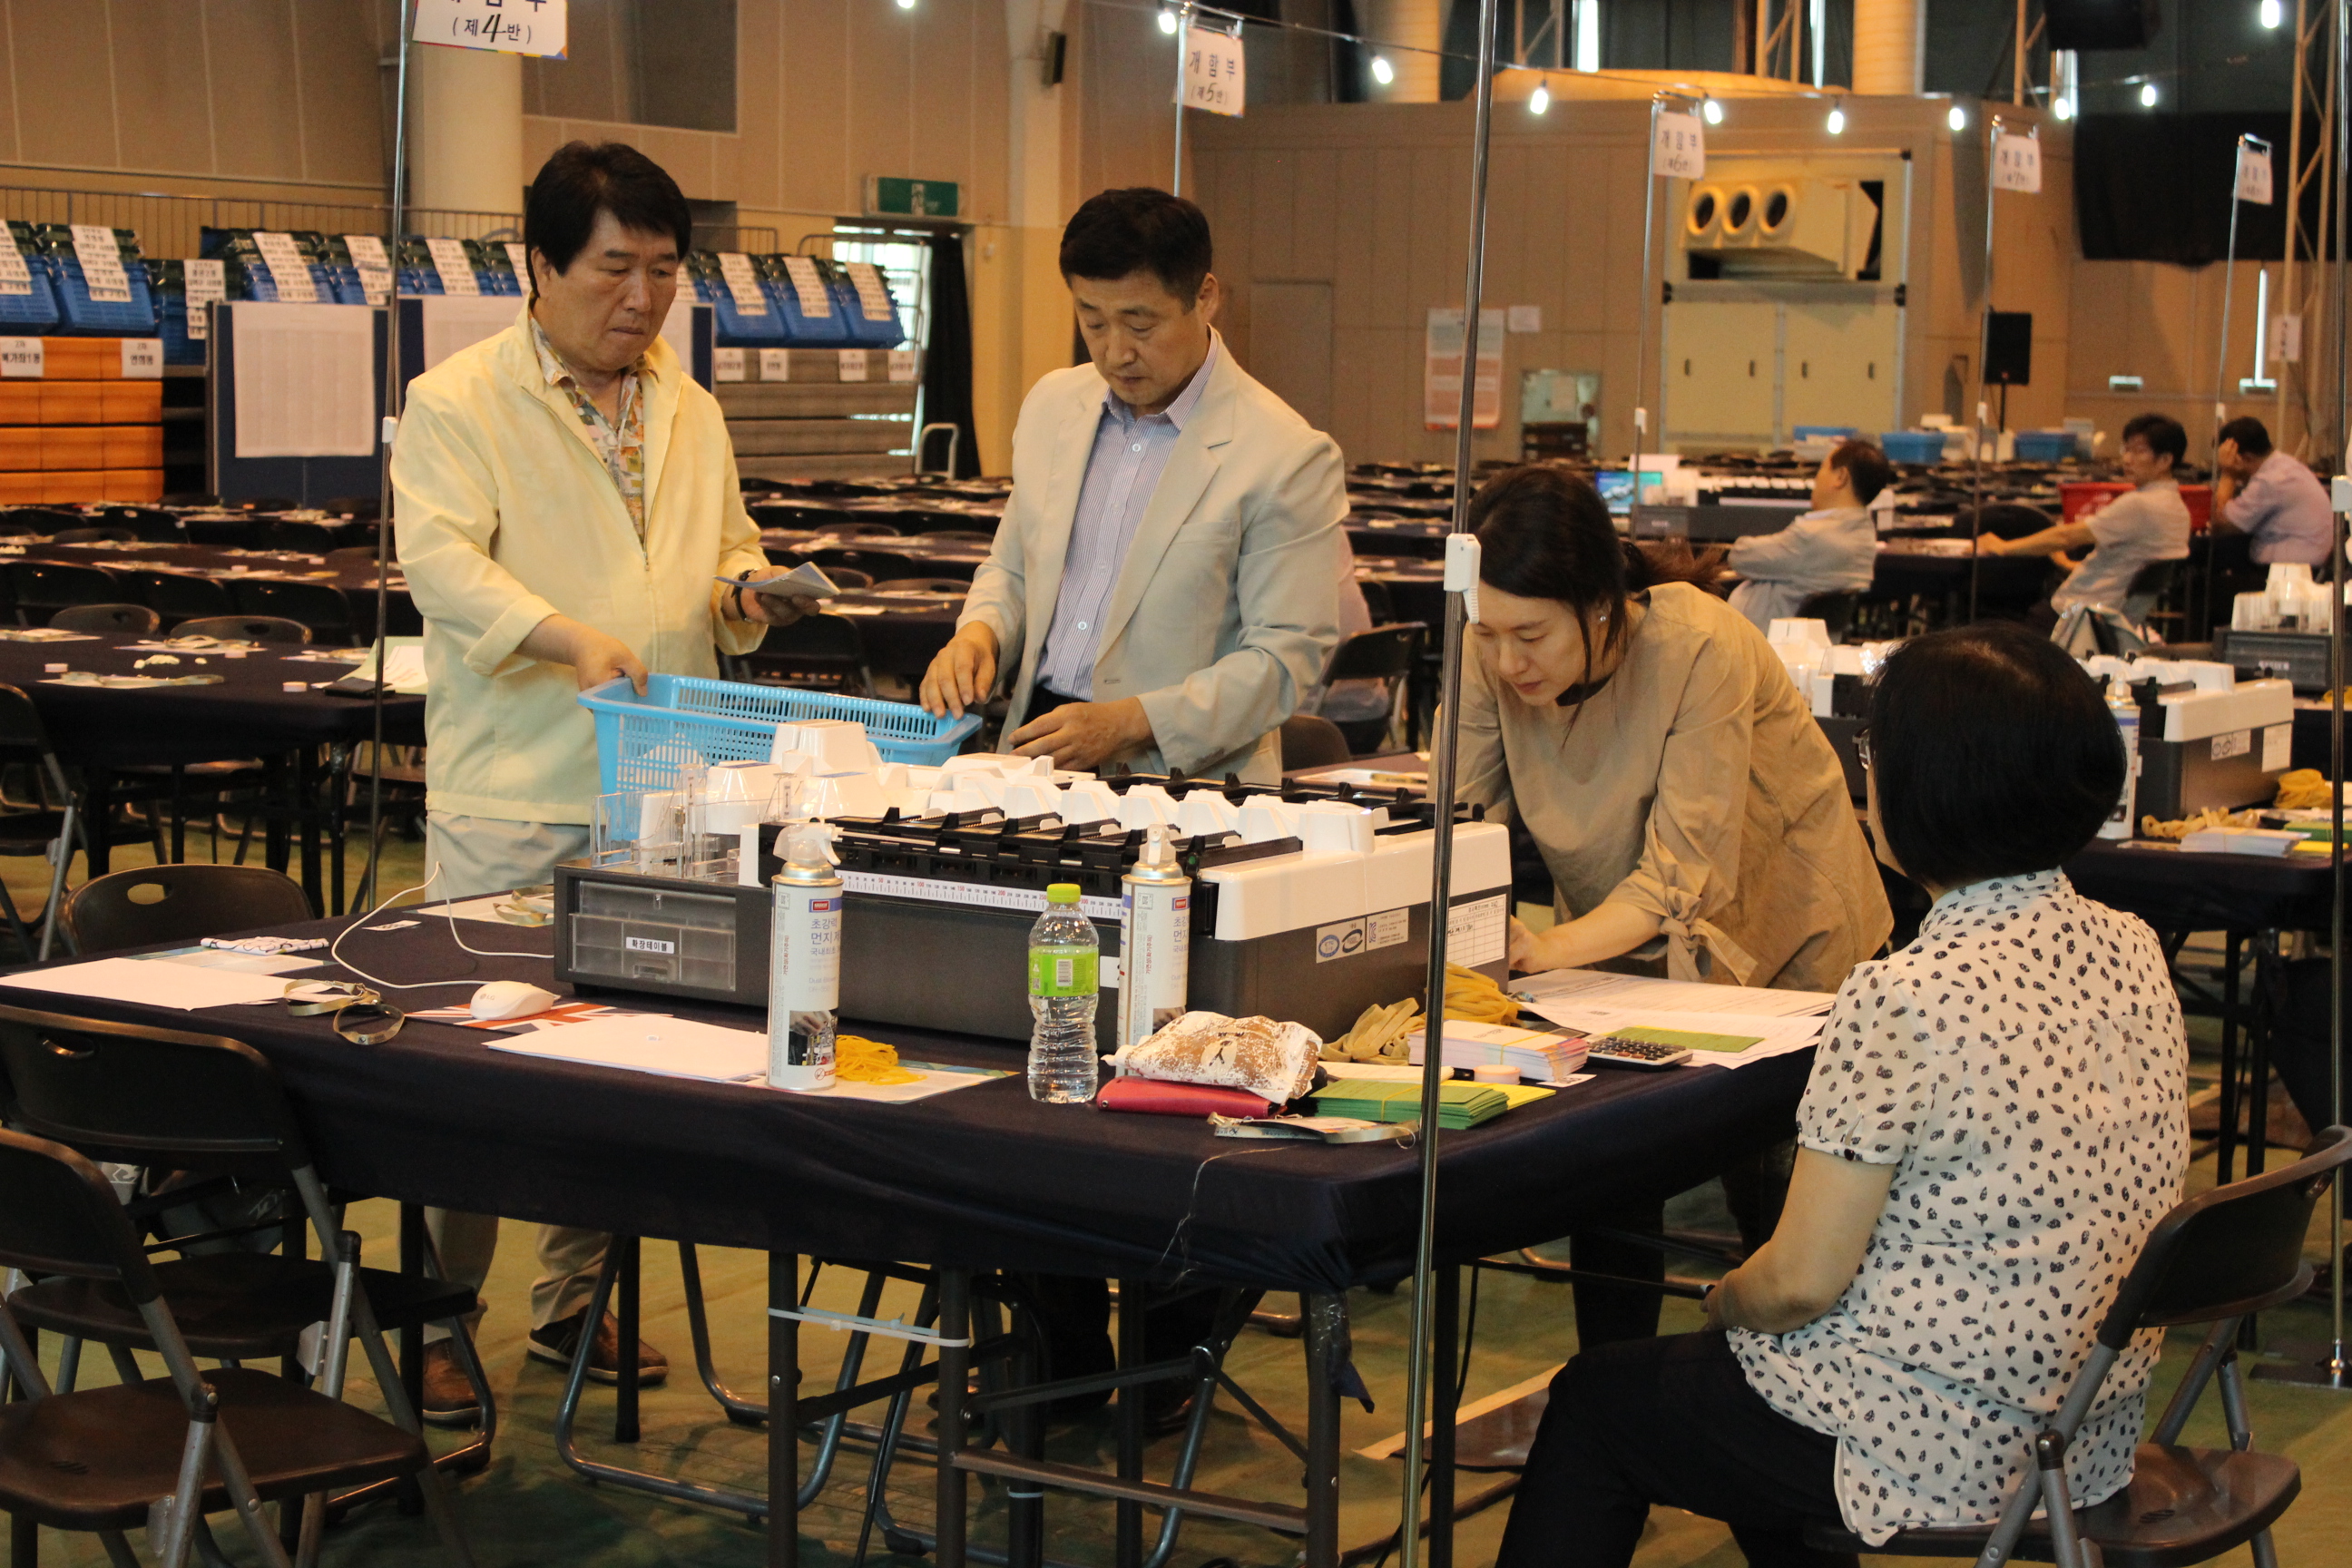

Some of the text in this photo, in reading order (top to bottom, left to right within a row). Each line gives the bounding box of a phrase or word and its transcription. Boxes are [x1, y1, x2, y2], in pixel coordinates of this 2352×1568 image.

[452, 13, 532, 44] (제4반)
[810, 916, 838, 930] 초강력
[632, 938, 668, 952] 확장테이블
